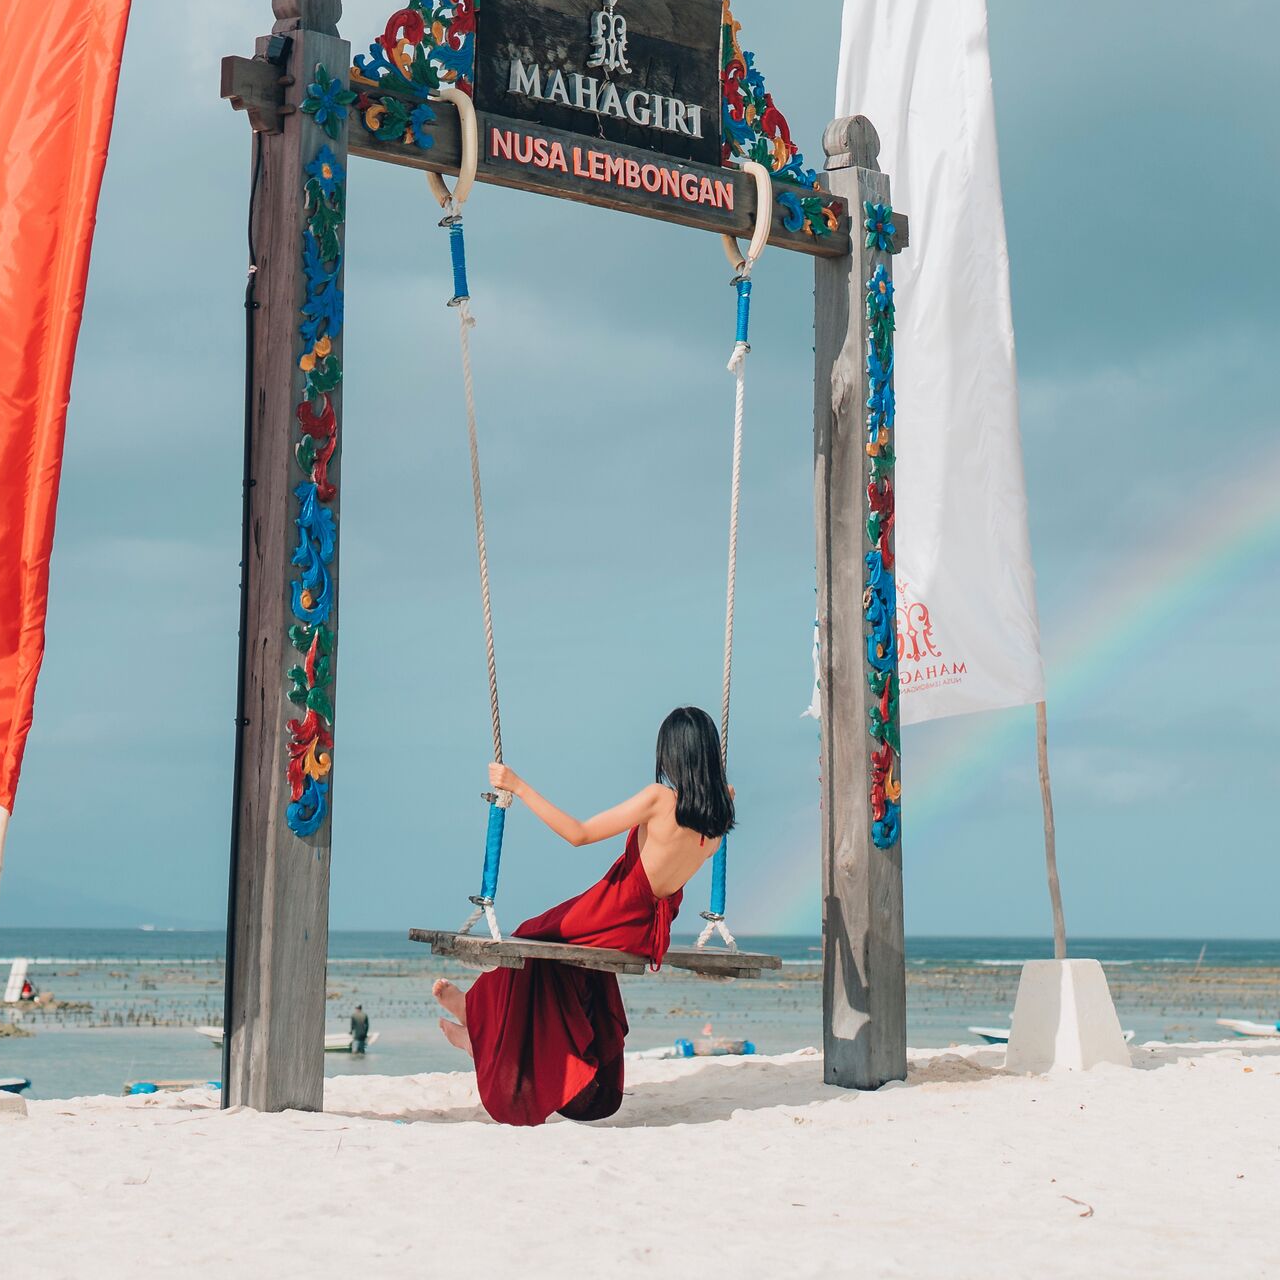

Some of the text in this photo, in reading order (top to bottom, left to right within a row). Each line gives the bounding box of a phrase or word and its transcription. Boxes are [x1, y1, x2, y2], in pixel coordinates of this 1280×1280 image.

[508, 59, 704, 139] MAHAGIRI
[491, 128, 734, 210] NUSA LEMBONGAN
